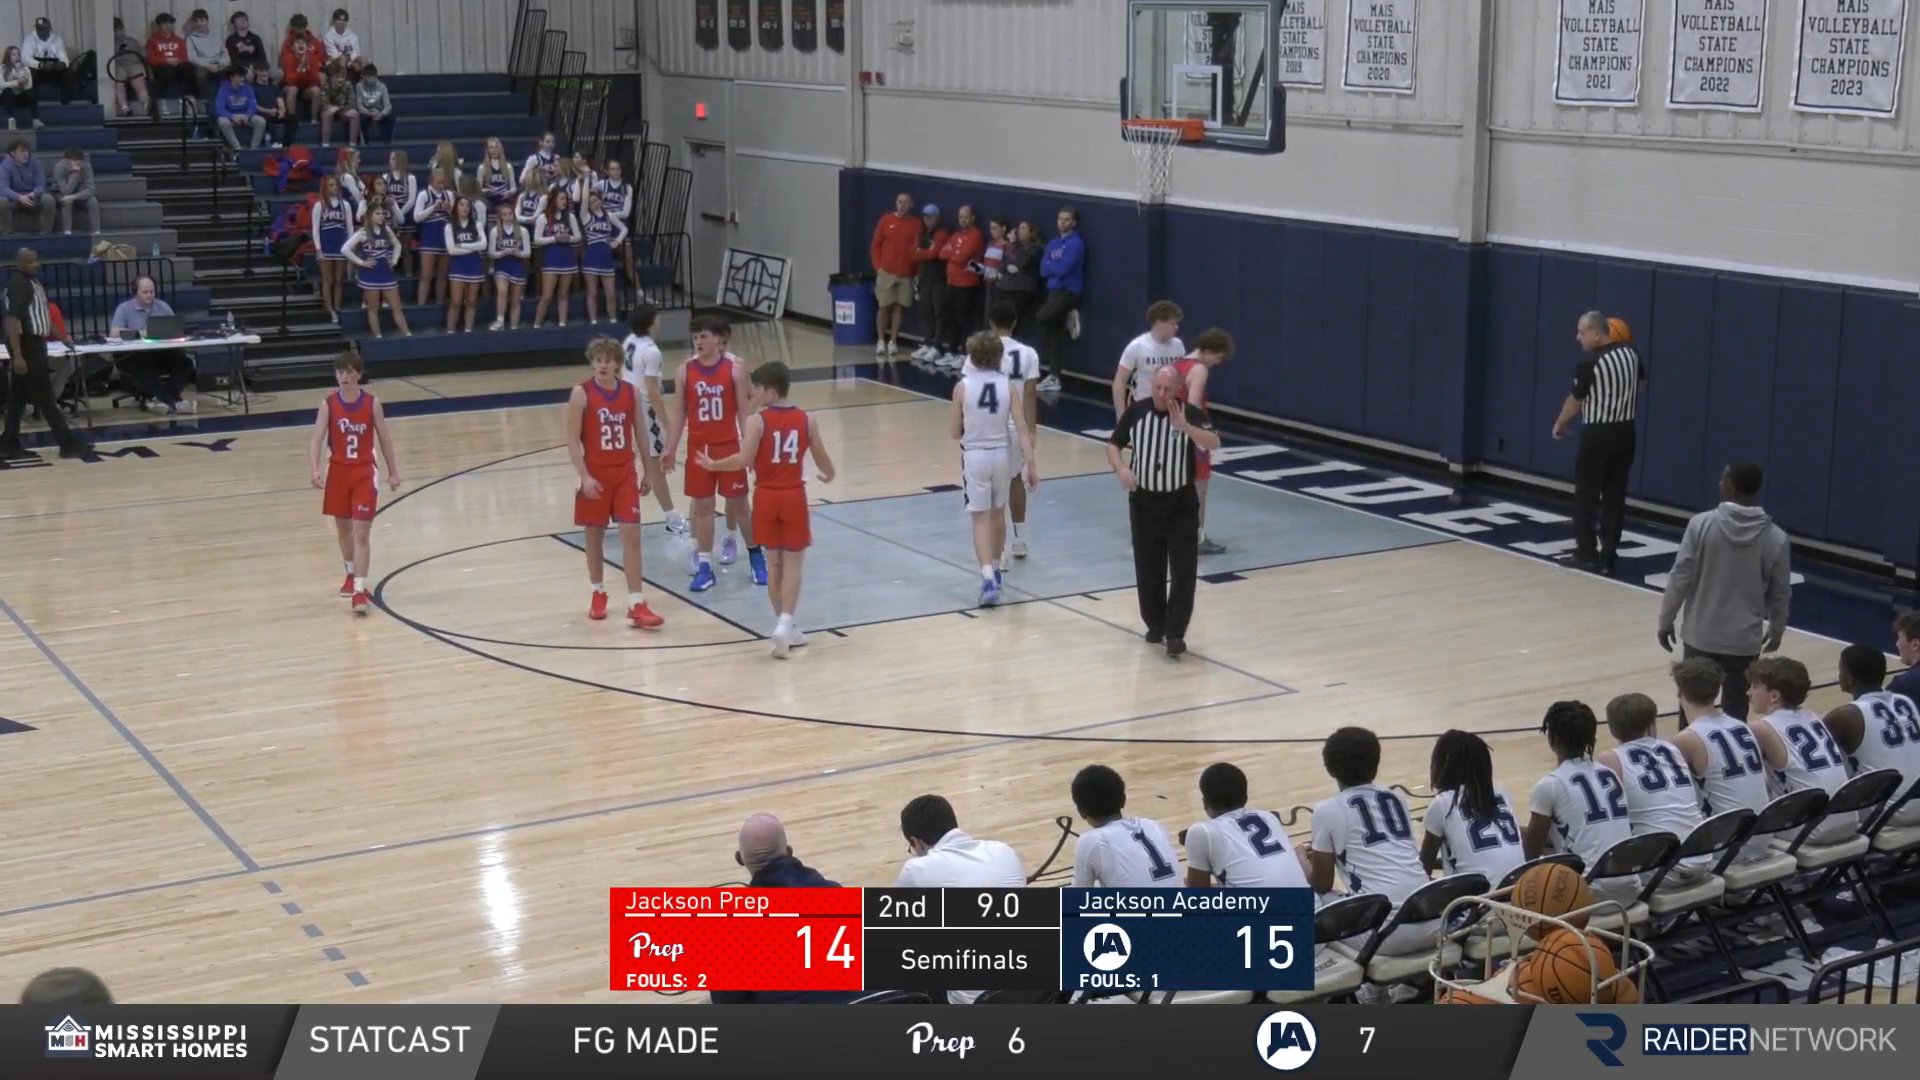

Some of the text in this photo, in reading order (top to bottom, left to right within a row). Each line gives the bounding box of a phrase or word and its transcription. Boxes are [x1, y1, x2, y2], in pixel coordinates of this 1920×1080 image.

[1370, 3, 1394, 18] MAIS
[1588, 0, 1615, 14] MAIS
[1353, 18, 1412, 35] VOLLEYBALL
[1563, 17, 1640, 34] VOLLEYBALL
[1681, 15, 1761, 32] VOLLEYBALL
[1808, 16, 1898, 36] VOLLEYBALL
[1282, 31, 1307, 44] STATE
[1367, 35, 1394, 50] STATE
[1582, 37, 1619, 53] STATE
[1698, 36, 1737, 53] STATE
[1828, 38, 1870, 55] STATE
[1285, 60, 1303, 73] 2019
[1356, 51, 1408, 66] CHAMPIONS
[1568, 56, 1633, 72] CHAMPIONS
[1684, 57, 1753, 74] CHAMPIONS
[1367, 67, 1390, 81] 2020
[1811, 58, 1890, 78] CHAMPIONS
[1585, 75, 1611, 90] 2021
[1699, 77, 1729, 93] 2022
[1830, 79, 1864, 97] 2023
[1008, 350, 1024, 380] 1
[695, 381, 723, 397] Prep
[976, 382, 999, 414] 4
[598, 407, 626, 424] Prep
[699, 397, 723, 422] 20
[338, 418, 367, 435] Prep
[601, 425, 625, 450] 23
[346, 435, 358, 459] 2
[772, 430, 799, 464] 14
[1870, 698, 1920, 749] 33
[1705, 726, 1764, 781] 15
[1785, 719, 1842, 773] 22
[1626, 743, 1693, 794] 31
[1569, 768, 1629, 826] 12
[1346, 790, 1412, 848] 10
[1236, 811, 1286, 859] 2
[1131, 828, 1176, 881] 1
